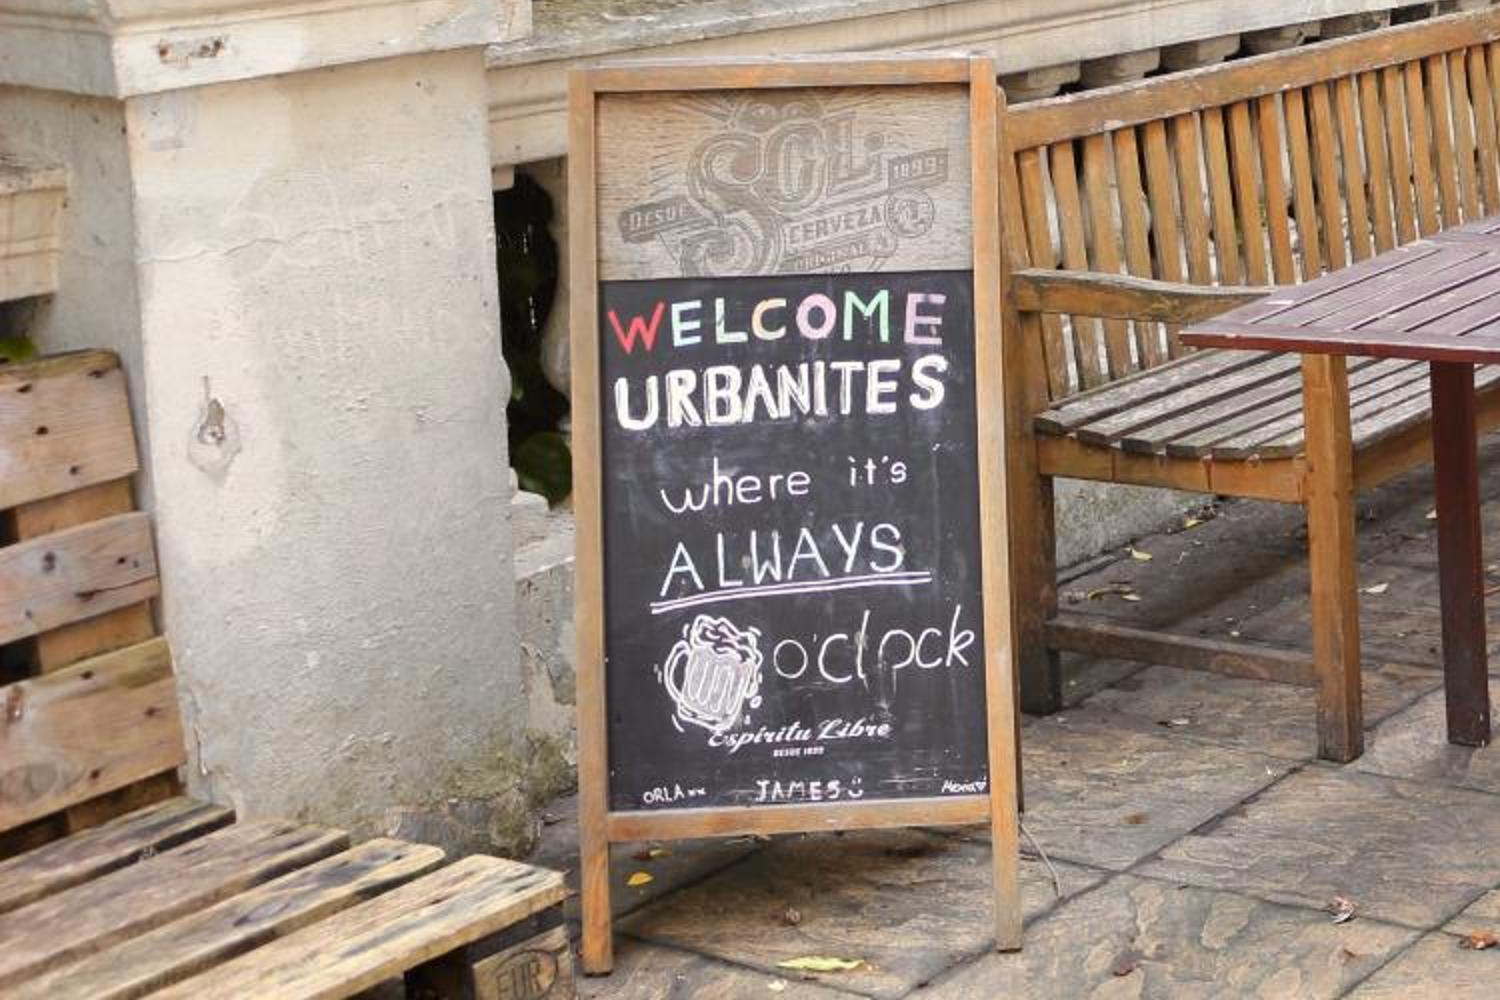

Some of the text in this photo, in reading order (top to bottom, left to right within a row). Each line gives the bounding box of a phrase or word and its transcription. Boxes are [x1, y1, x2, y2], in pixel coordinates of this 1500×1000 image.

[788, 204, 882, 245] CERVEZA
[608, 289, 947, 354] WELCOME
[614, 354, 949, 431] URBANITES
[660, 456, 907, 514] where it's
[660, 522, 903, 597] ALWAYS
[817, 717, 892, 741] Libre
[642, 784, 685, 804] ORLA
[755, 779, 841, 801] JAMES
